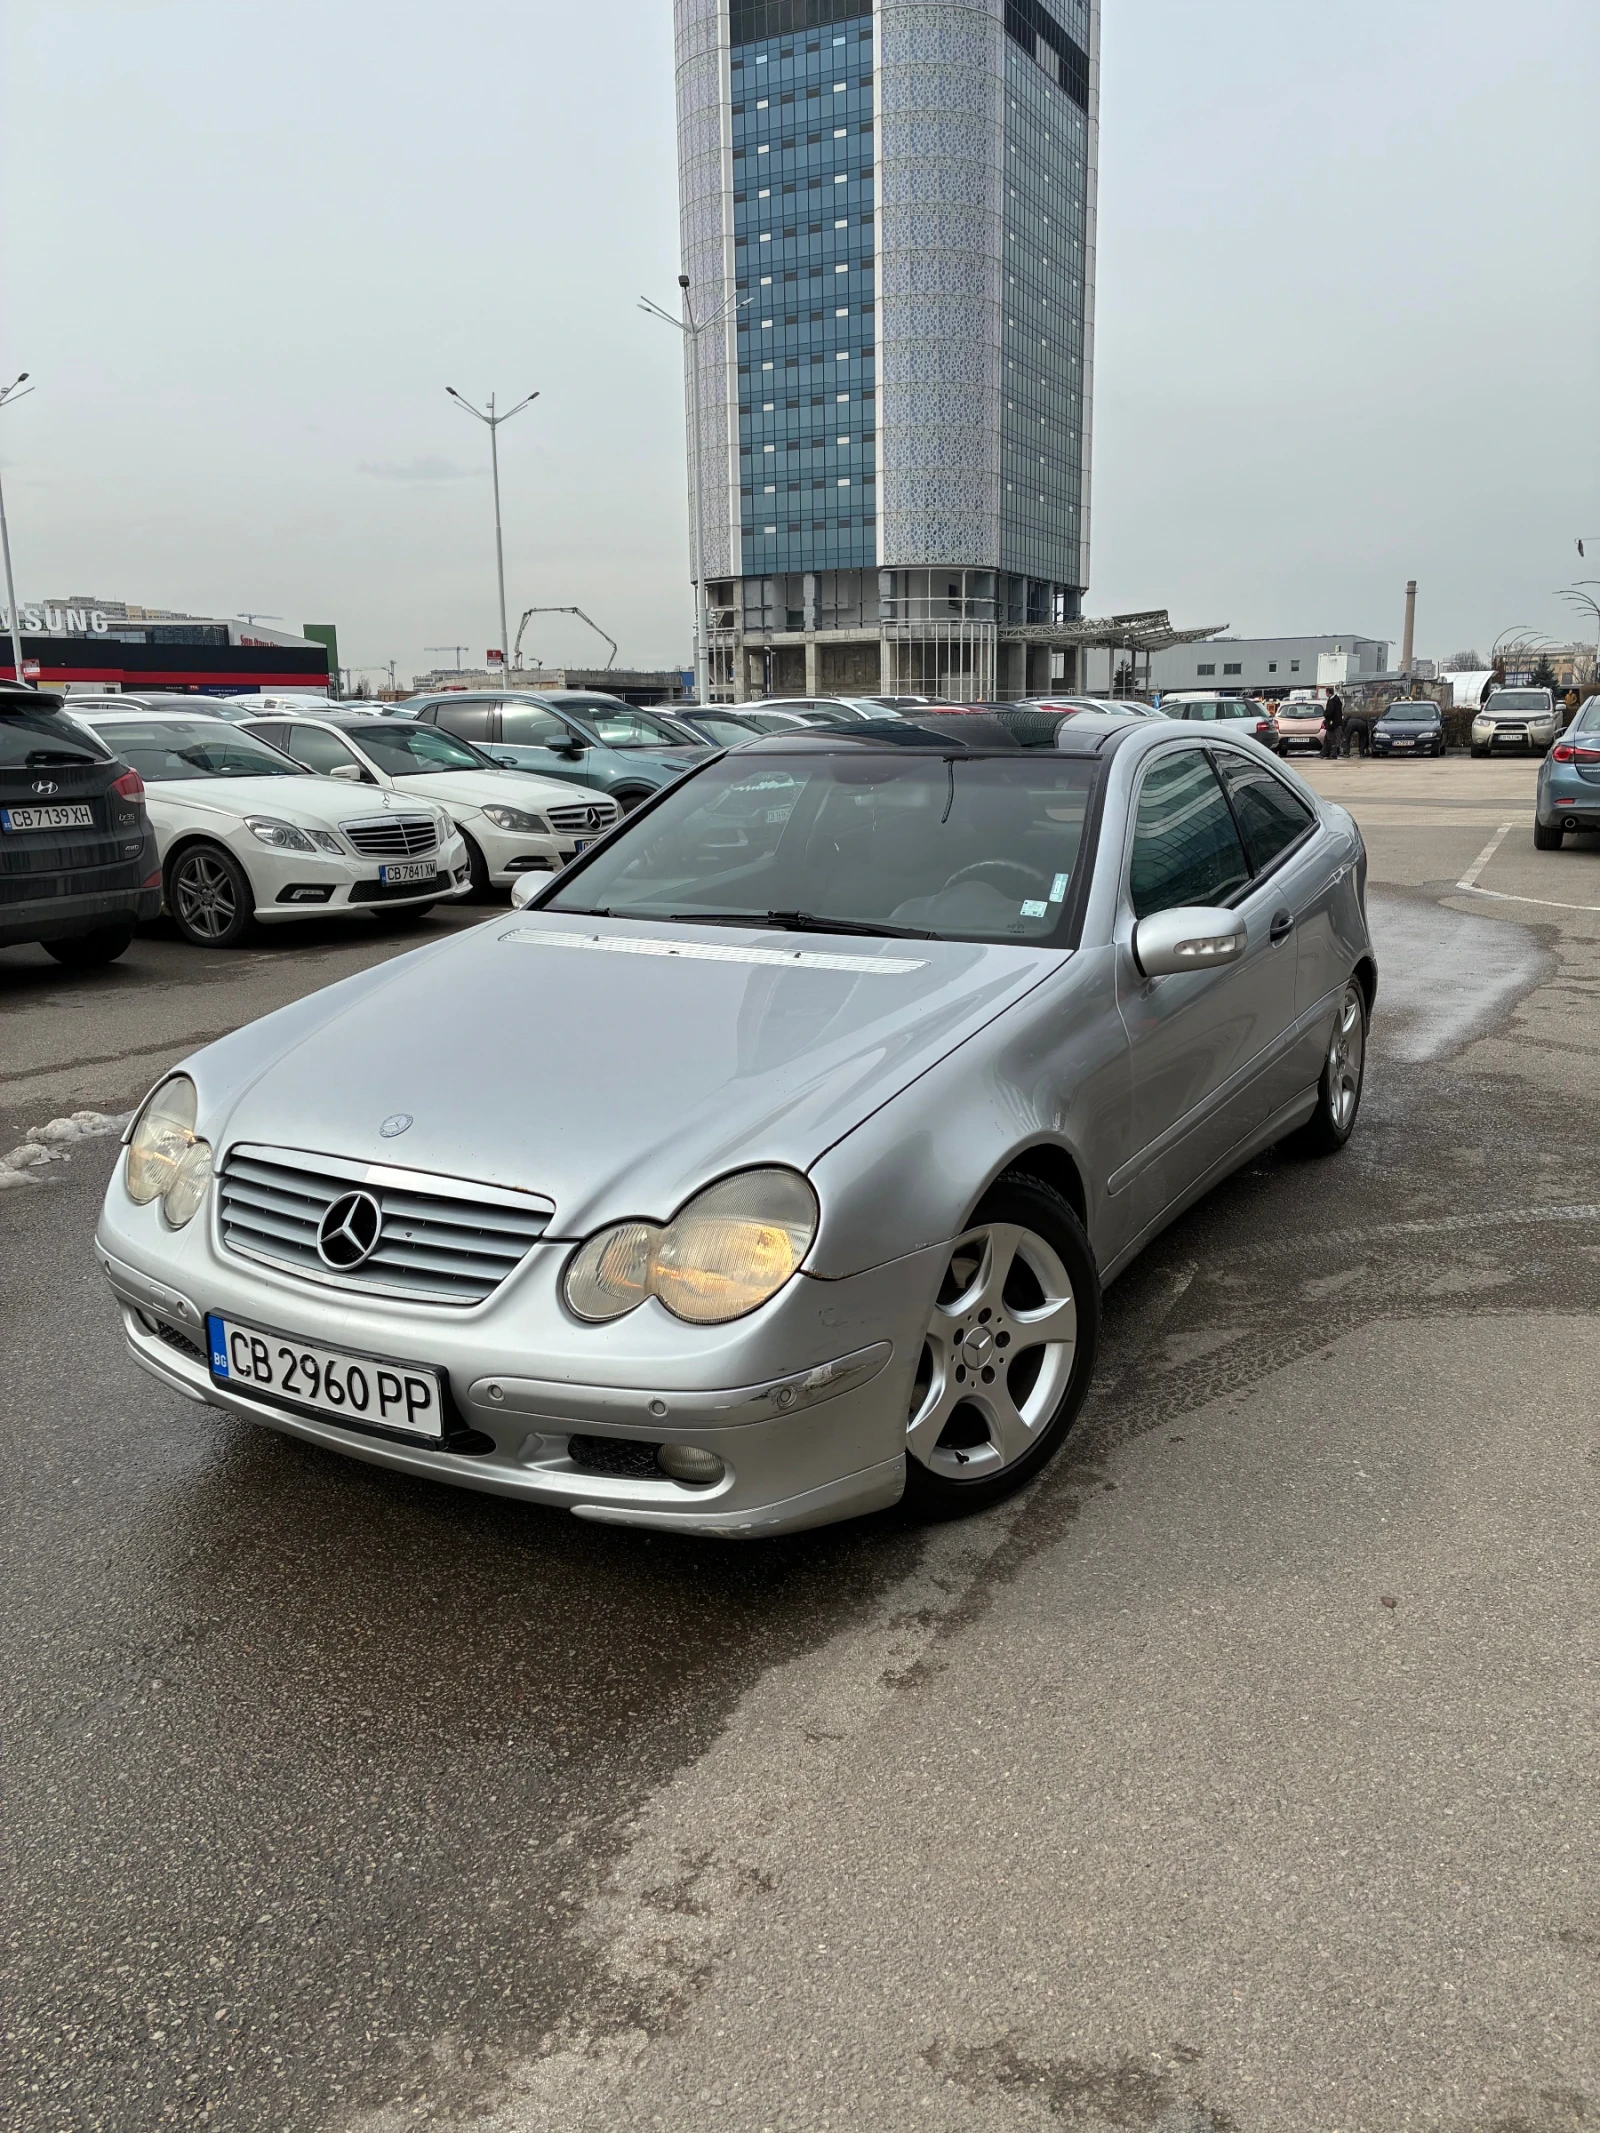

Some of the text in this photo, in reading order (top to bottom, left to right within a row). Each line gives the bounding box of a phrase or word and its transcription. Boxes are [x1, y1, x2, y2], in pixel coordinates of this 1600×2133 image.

[12, 810, 33, 827] CB
[34, 808, 69, 826] 7139
[71, 807, 91, 823] XH
[387, 863, 435, 880] CB 7841 XM
[214, 1331, 431, 1423] BG CB 2960 PP
